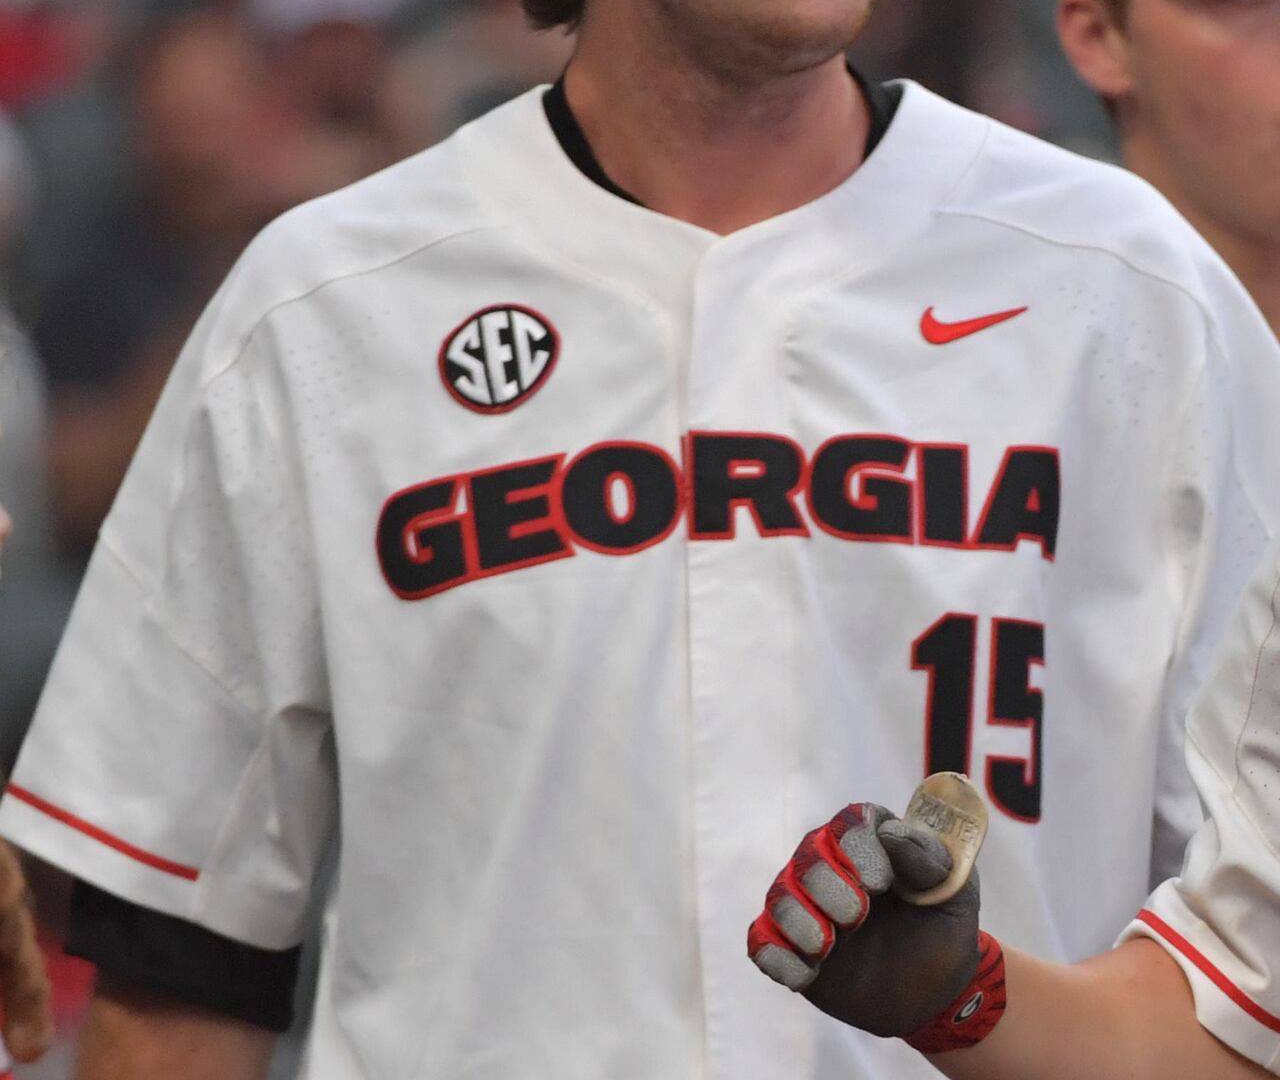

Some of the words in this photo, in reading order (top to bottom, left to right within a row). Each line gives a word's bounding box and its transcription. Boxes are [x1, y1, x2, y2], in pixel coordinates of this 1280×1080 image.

[443, 307, 555, 407] SEC
[375, 429, 1061, 601] GEORGIA
[910, 611, 1046, 824] 15
